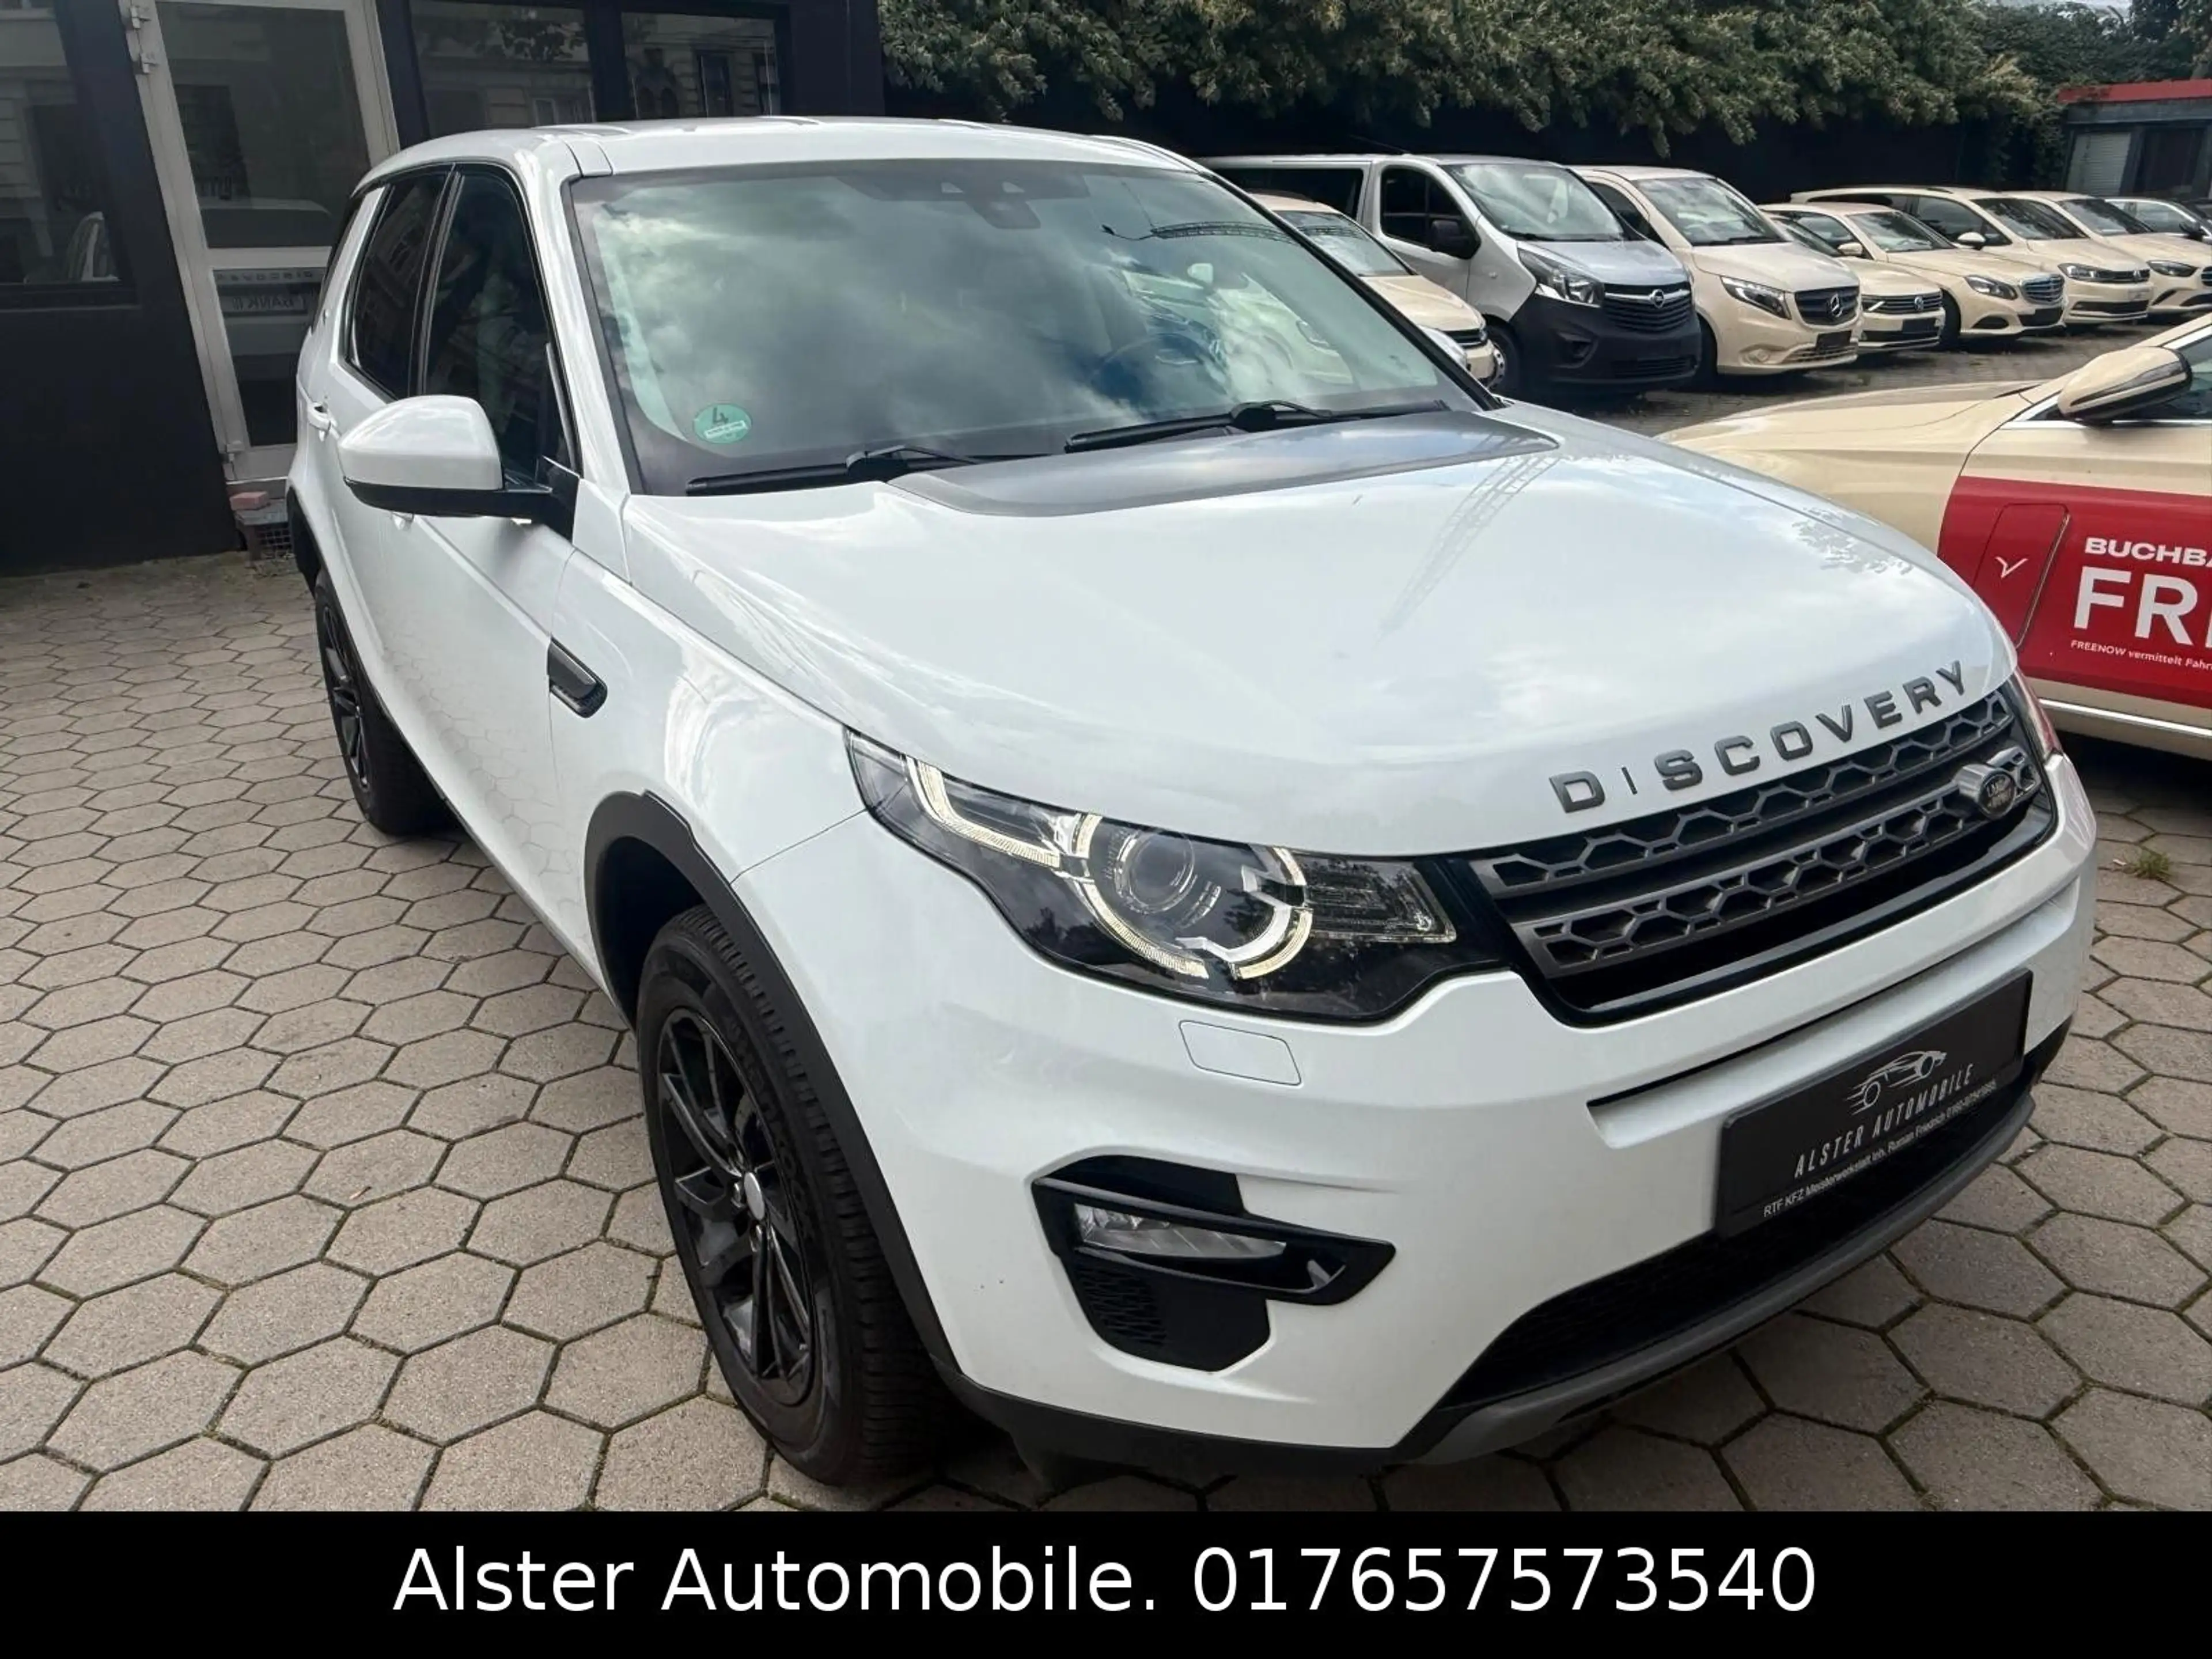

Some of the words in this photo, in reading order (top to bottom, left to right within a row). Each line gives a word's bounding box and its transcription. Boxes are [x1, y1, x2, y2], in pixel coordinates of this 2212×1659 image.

[713, 407, 729, 424] 4
[2084, 536, 2212, 567] BUCHB
[2071, 639, 2126, 656] FREENOW
[2128, 650, 2183, 666] vermittelt
[1549, 660, 1965, 813] DISCOVERY
[1794, 1126, 1864, 1180] ALSTER
[1872, 1063, 1974, 1139] AUTOMOBILE
[1763, 1198, 1784, 1218] RTF
